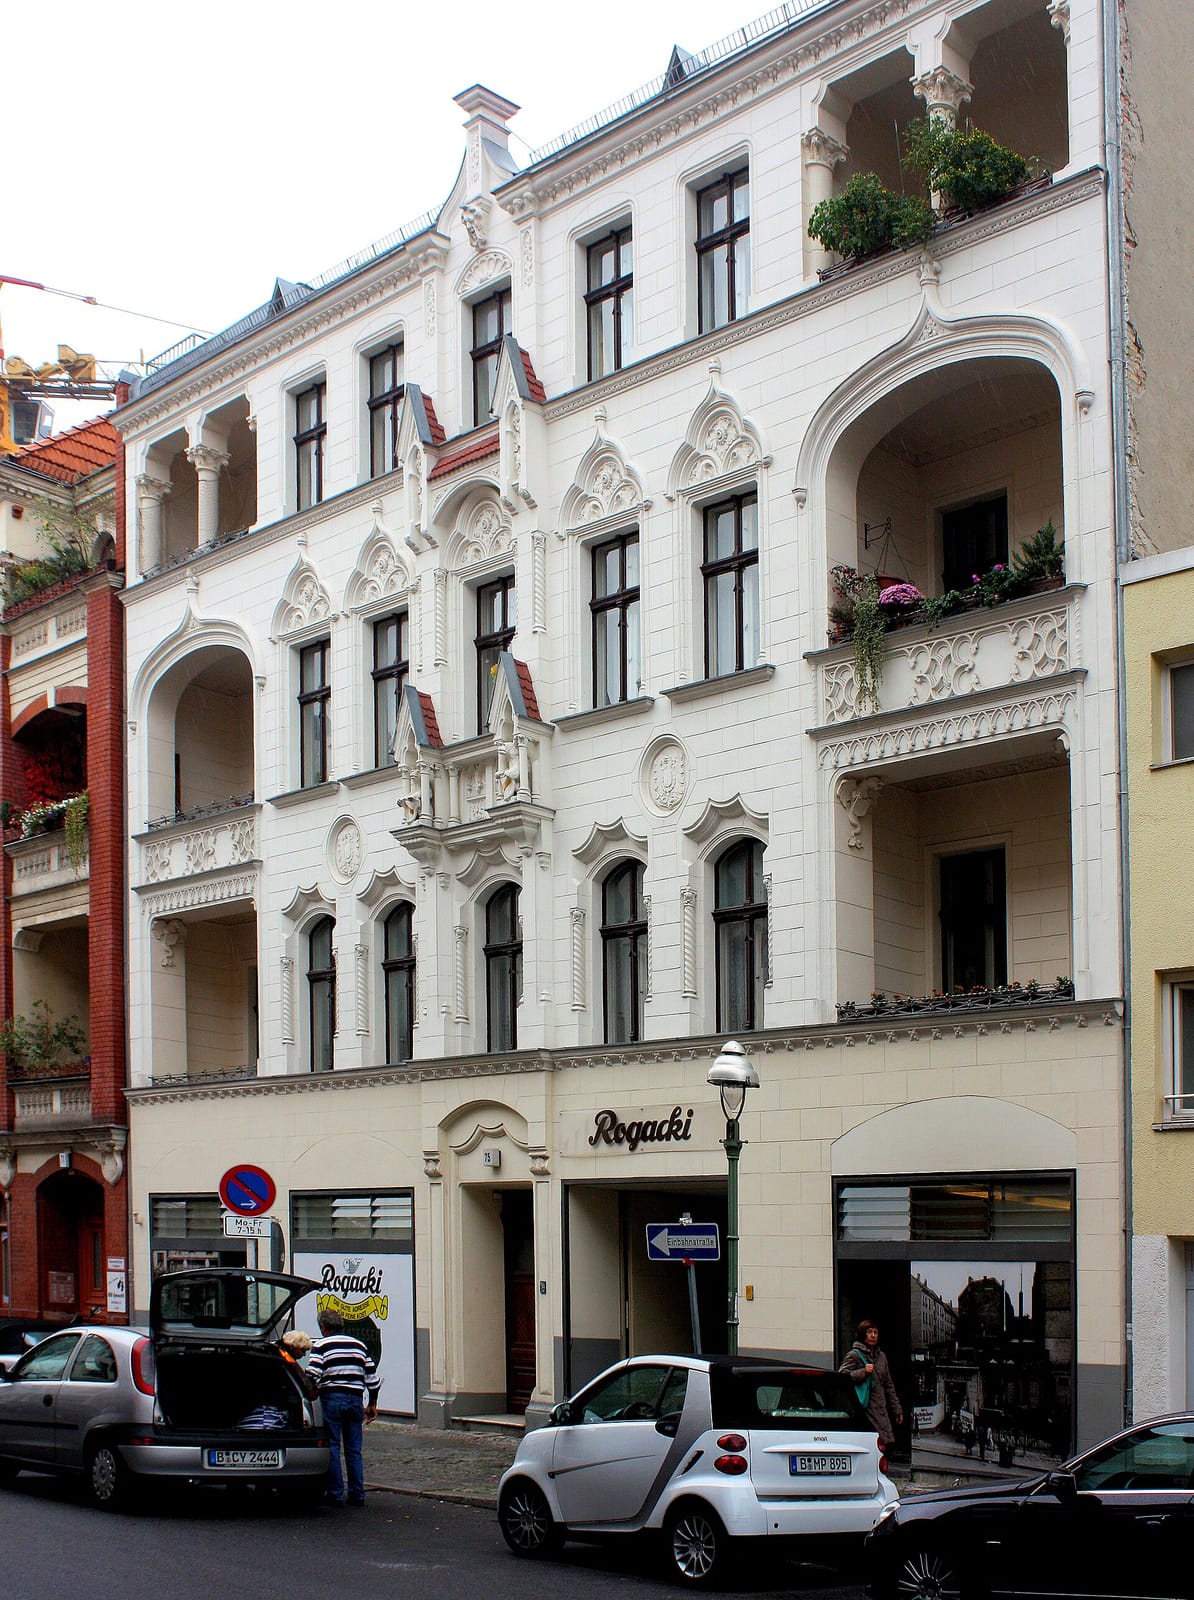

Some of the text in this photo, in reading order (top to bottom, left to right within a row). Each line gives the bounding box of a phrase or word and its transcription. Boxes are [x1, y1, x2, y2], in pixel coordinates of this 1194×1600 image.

[588, 1106, 694, 1152] Rogacki
[484, 1152, 491, 1163] 75
[235, 1219, 263, 1228] Mo-Fr
[237, 1226, 262, 1235] 7-15 h
[667, 1237, 715, 1247] Einbahnstraße
[319, 1263, 383, 1299] Rogacki
[249, 1451, 277, 1463] 2444
[829, 1457, 847, 1470] 895
